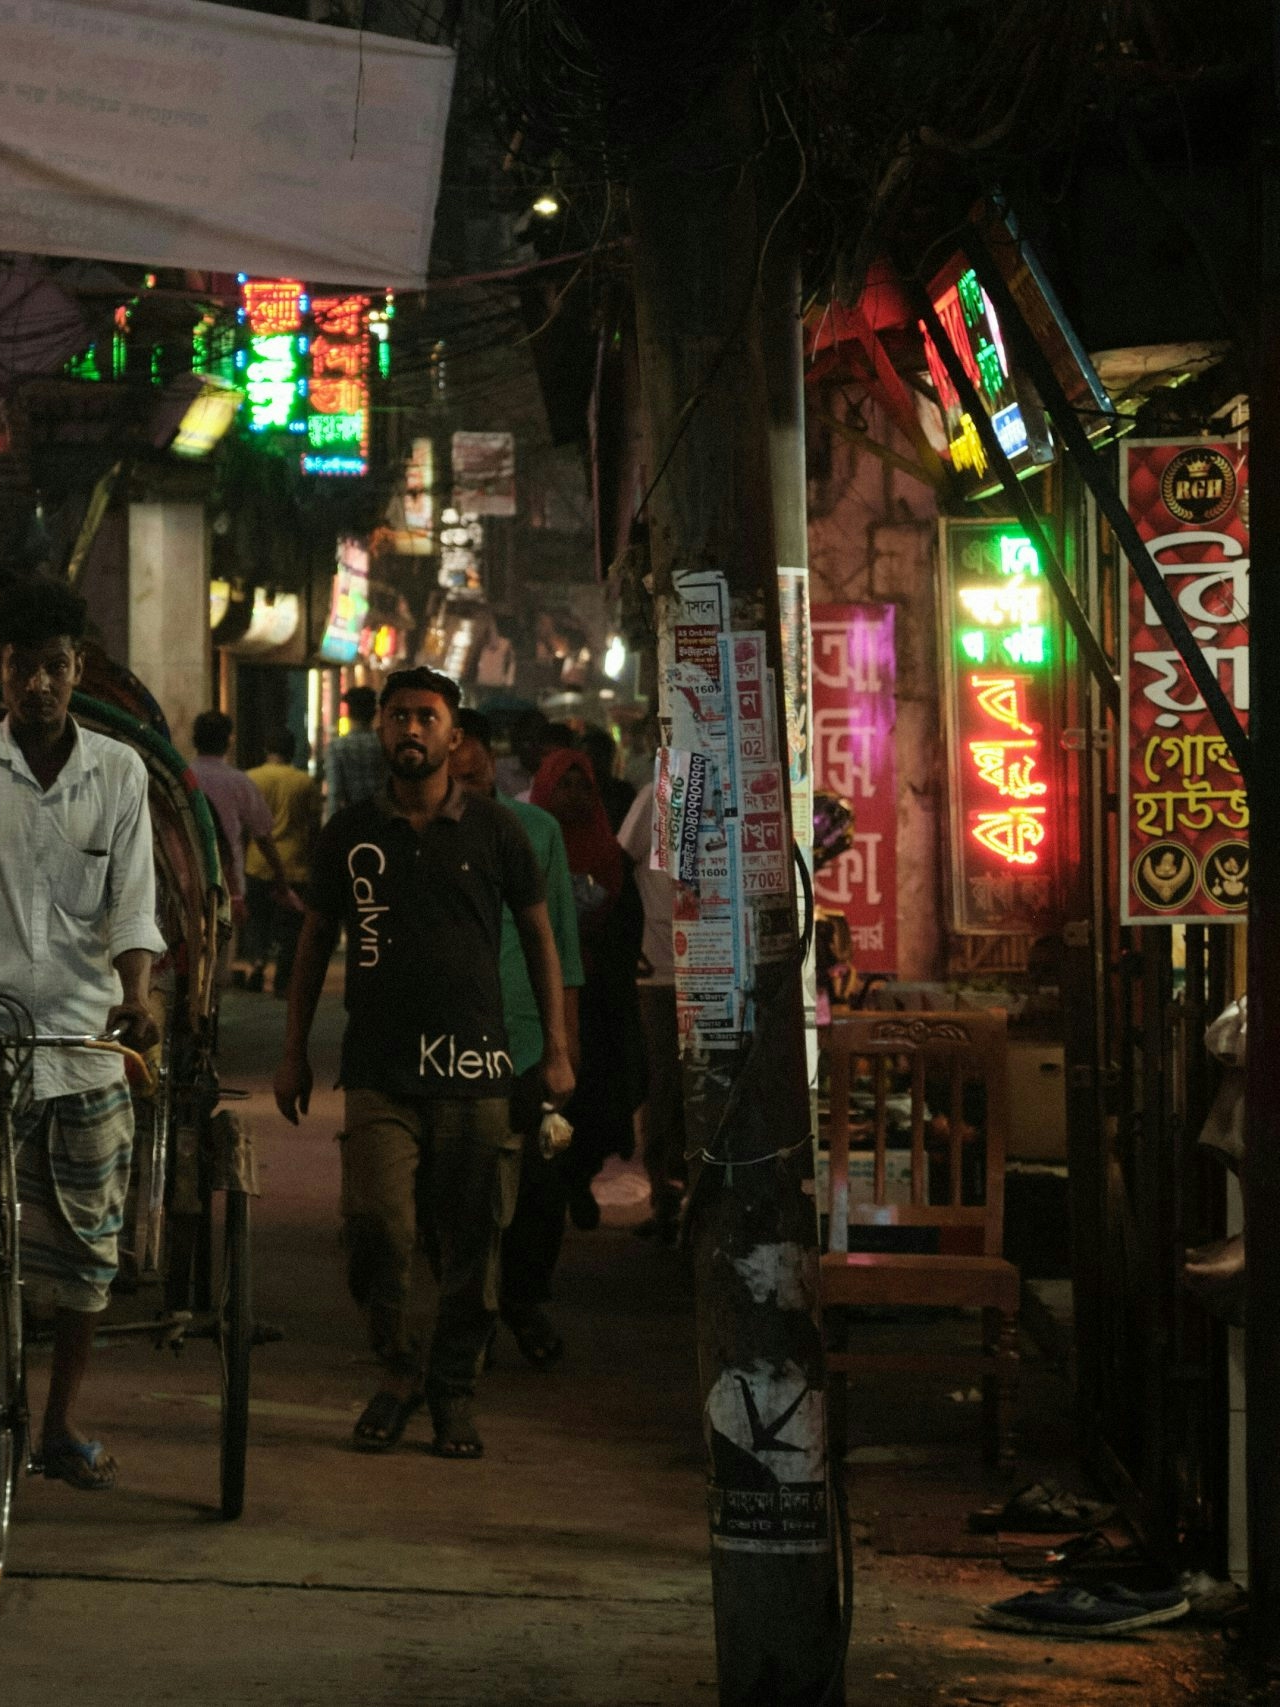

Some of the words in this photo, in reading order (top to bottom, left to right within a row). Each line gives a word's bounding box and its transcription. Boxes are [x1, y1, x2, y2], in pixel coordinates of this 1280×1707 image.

[1175, 479, 1223, 500] RGH
[348, 843, 390, 968] Calvin
[420, 1034, 514, 1079] Klein
